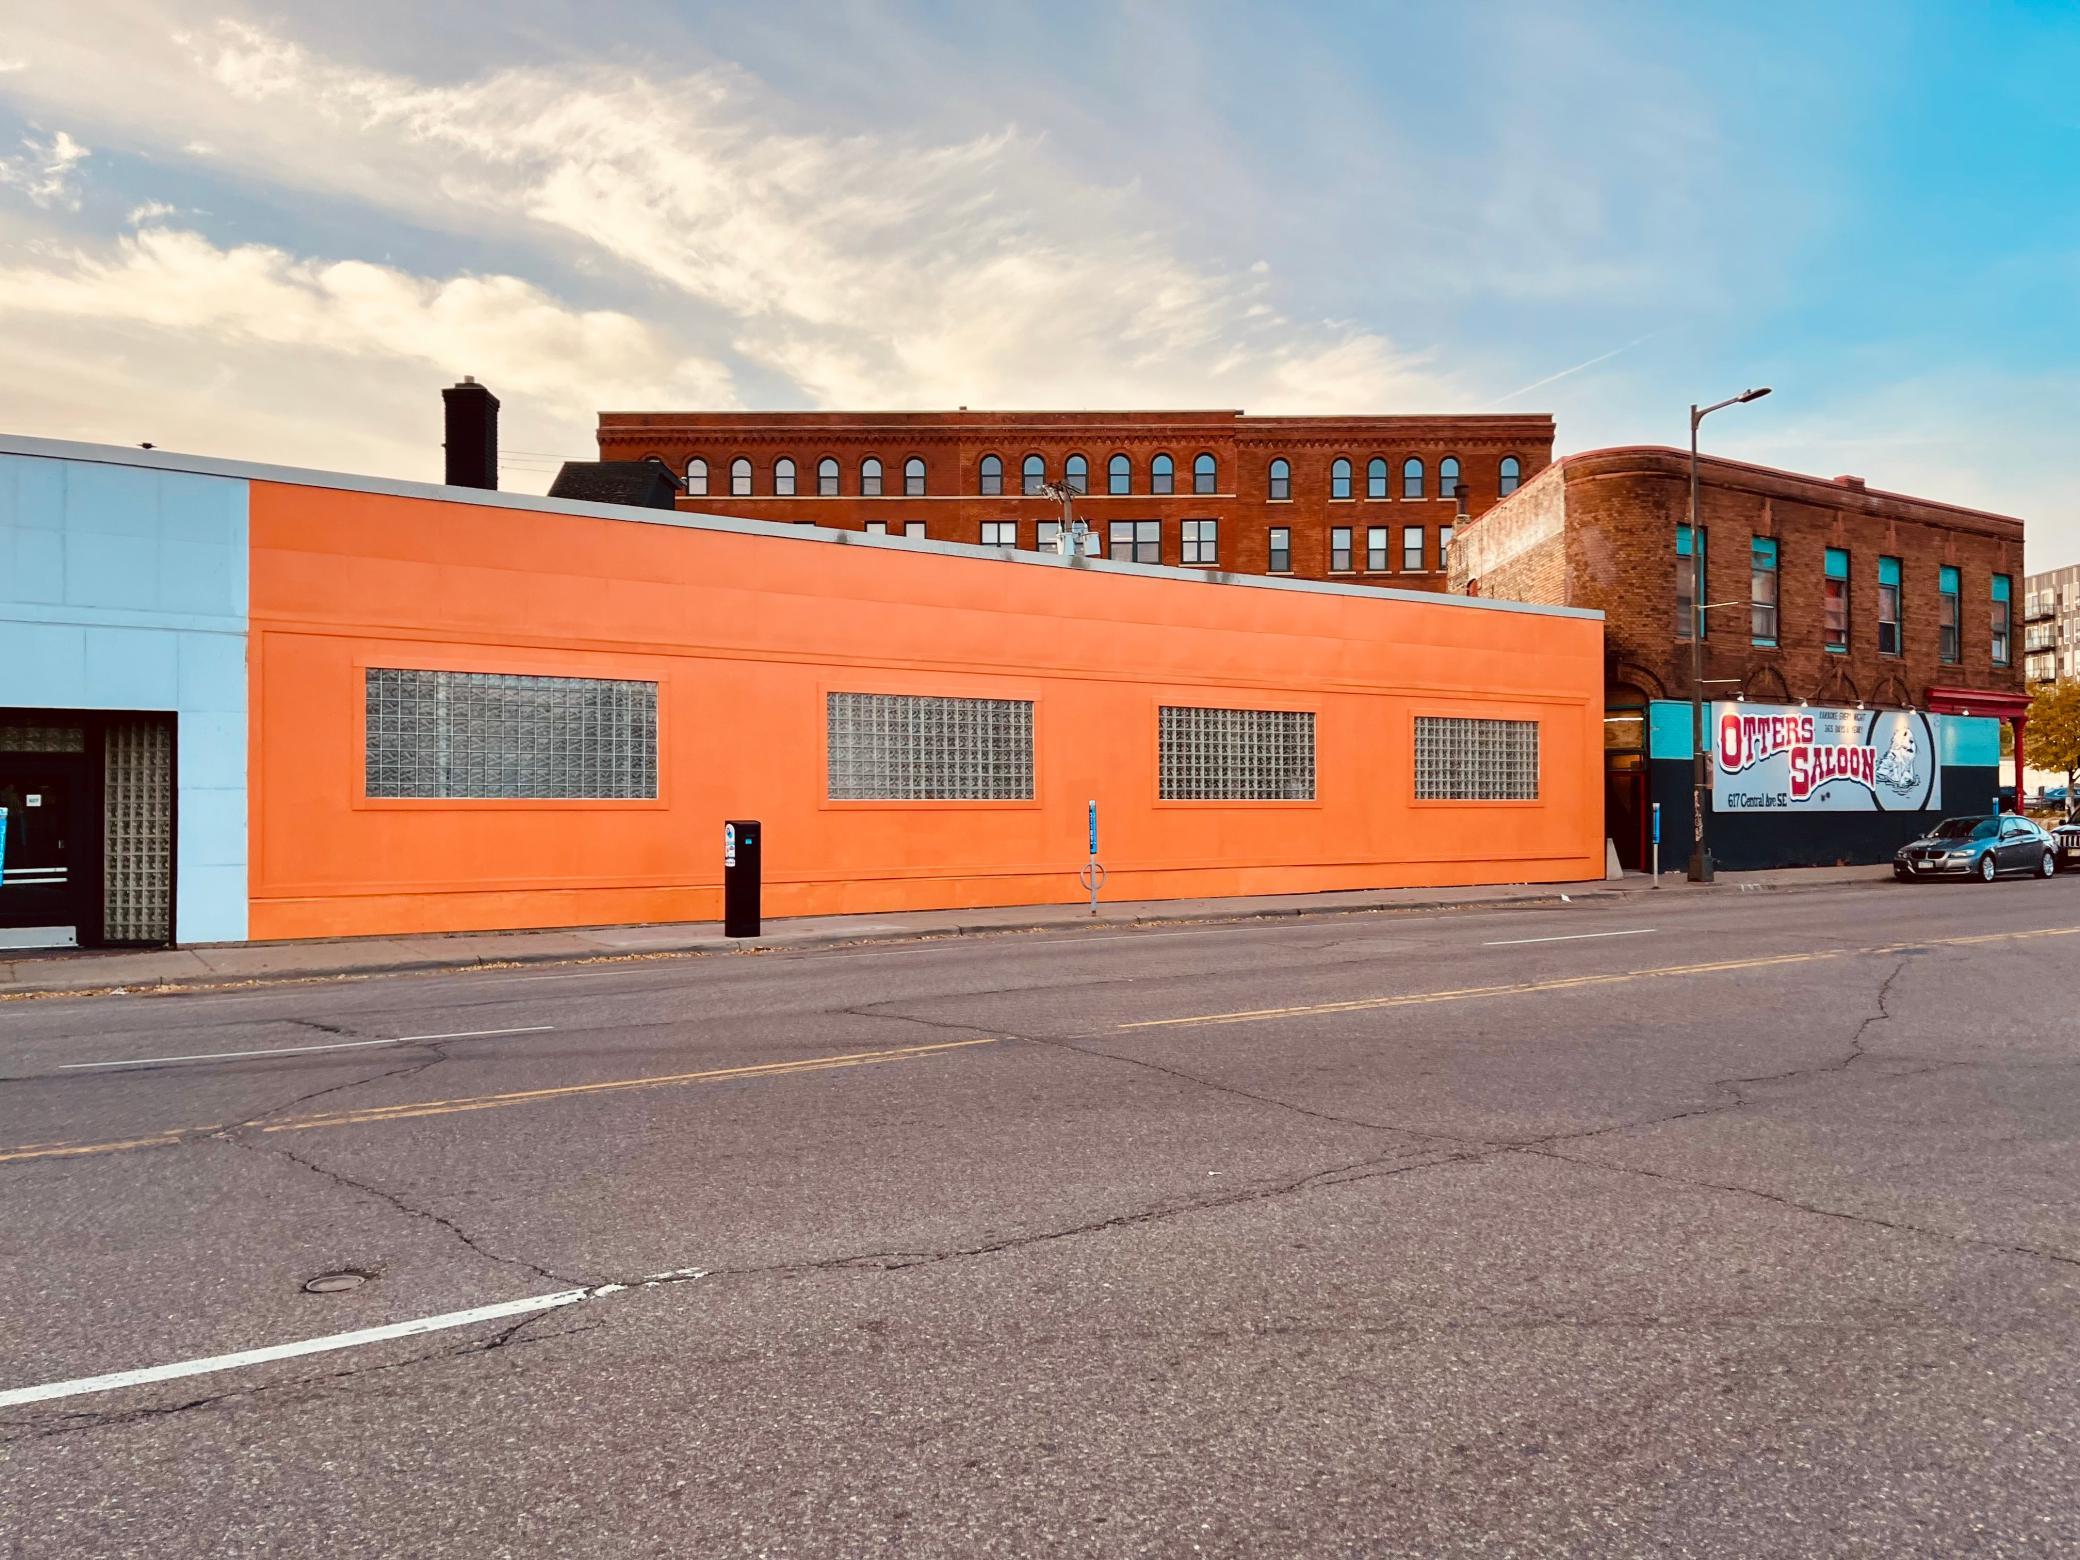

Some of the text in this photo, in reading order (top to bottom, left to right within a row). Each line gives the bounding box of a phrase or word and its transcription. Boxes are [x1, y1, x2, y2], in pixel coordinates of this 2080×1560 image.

[1790, 746, 1876, 796] SALOON
[1728, 793, 1787, 807] 617 Central Ave SE
